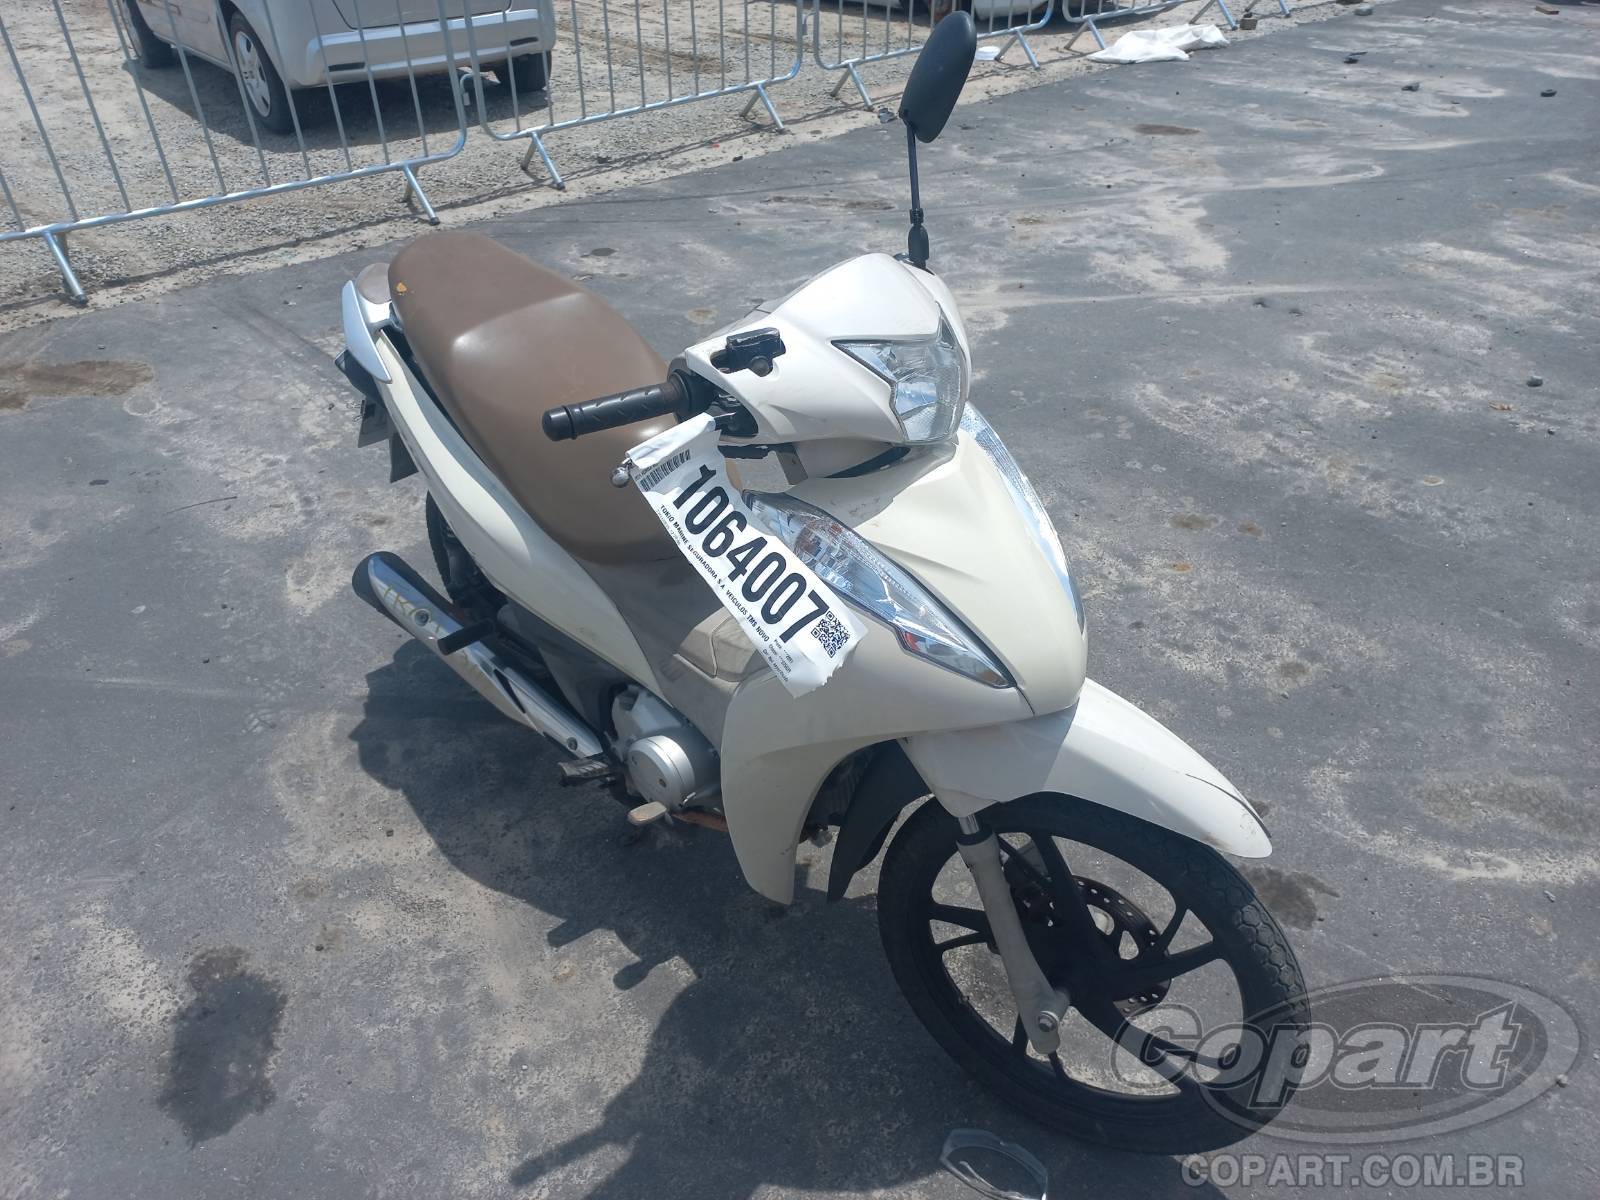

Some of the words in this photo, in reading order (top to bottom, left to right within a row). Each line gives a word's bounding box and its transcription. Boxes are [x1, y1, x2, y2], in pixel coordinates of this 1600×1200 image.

[660, 505, 675, 522] TOKIO
[672, 521, 689, 545] MARINE
[687, 544, 718, 579] SEGURADORA
[726, 589, 748, 616] VEICULOS
[747, 614, 758, 628] TMS
[756, 626, 770, 642] NOVO
[673, 464, 829, 643] 1064007
